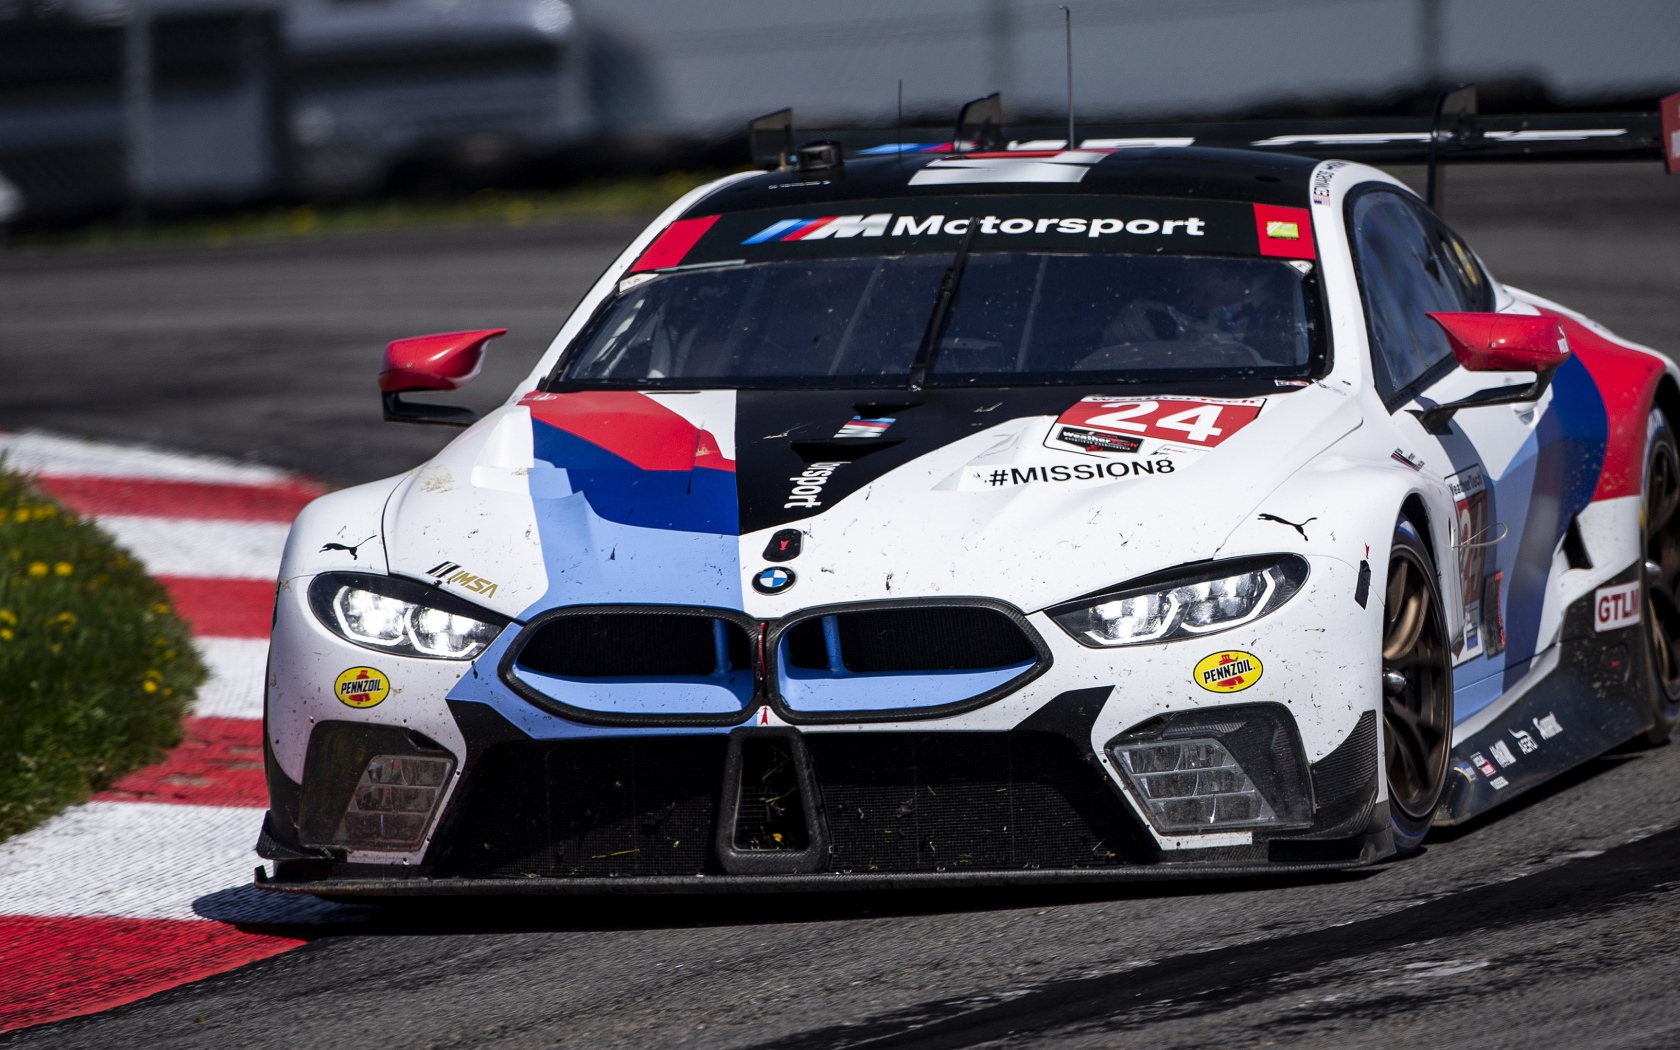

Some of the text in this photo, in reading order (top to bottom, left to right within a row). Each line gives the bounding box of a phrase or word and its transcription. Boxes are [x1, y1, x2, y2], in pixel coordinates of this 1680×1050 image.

[892, 214, 1206, 237] Motorsport
[1085, 400, 1223, 442] 24
[989, 459, 1176, 486] #MISSION8
[448, 570, 499, 599] IMSA
[1203, 659, 1255, 684] PENNZOIL
[340, 678, 383, 696] PENNZOIL
